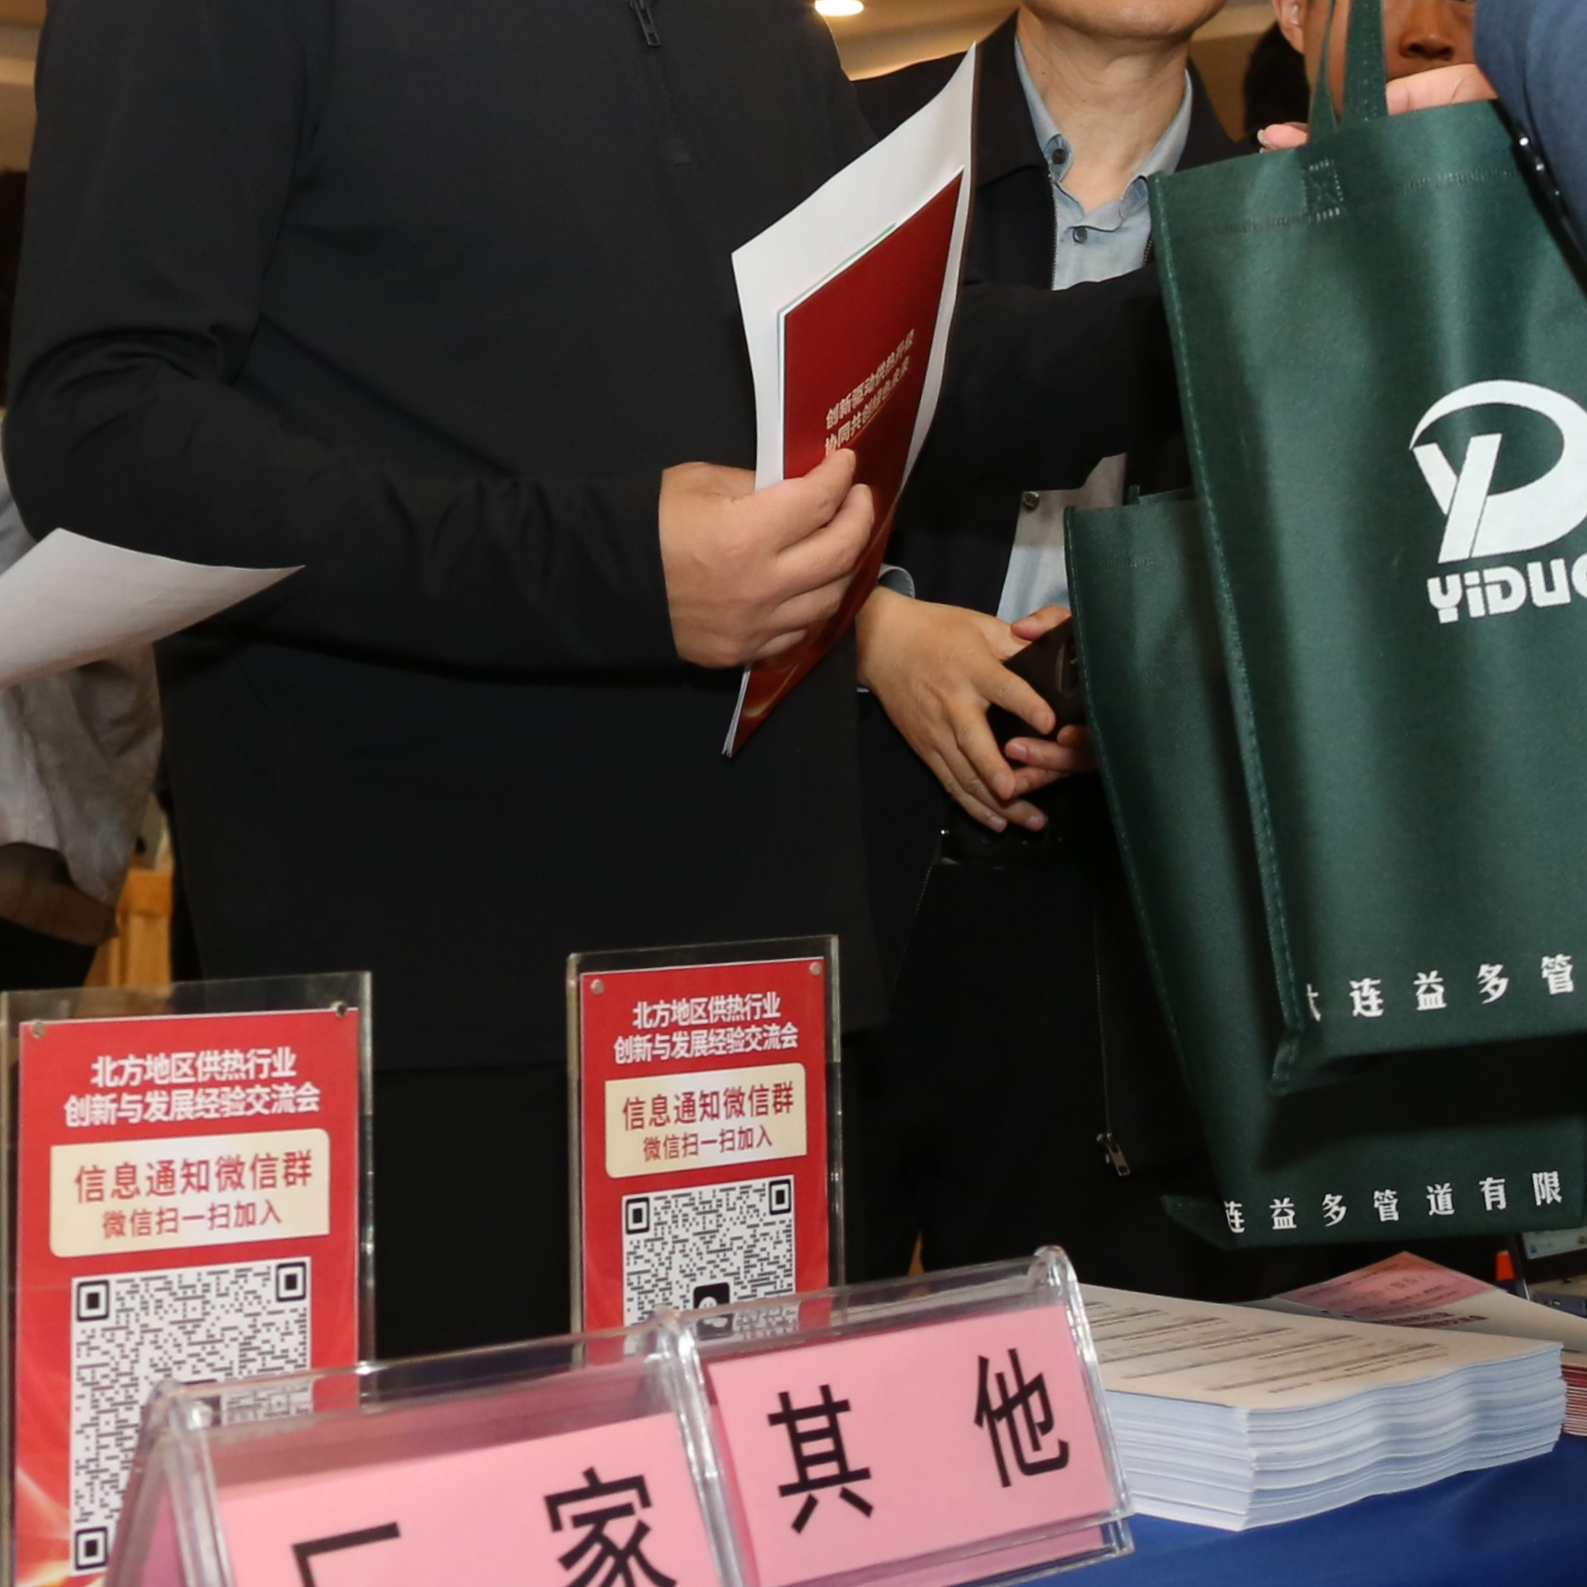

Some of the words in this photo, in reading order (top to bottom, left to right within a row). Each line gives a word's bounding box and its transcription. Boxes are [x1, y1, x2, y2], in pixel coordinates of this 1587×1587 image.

[632, 991, 782, 1030] 北方地区供热行业
[613, 1021, 799, 1065] 创新与发展经验交流会
[90, 1046, 298, 1089] 北方地区供热行业
[63, 1081, 321, 1128] 创新与发展经验交流会
[622, 1080, 795, 1132] 信息通知微信群
[643, 1124, 774, 1163] 微信扫一扫加入
[74, 1149, 314, 1205] 信息通知微信群
[102, 1199, 283, 1240] 微信扫一扫加入
[767, 1347, 1070, 1534] 其他
